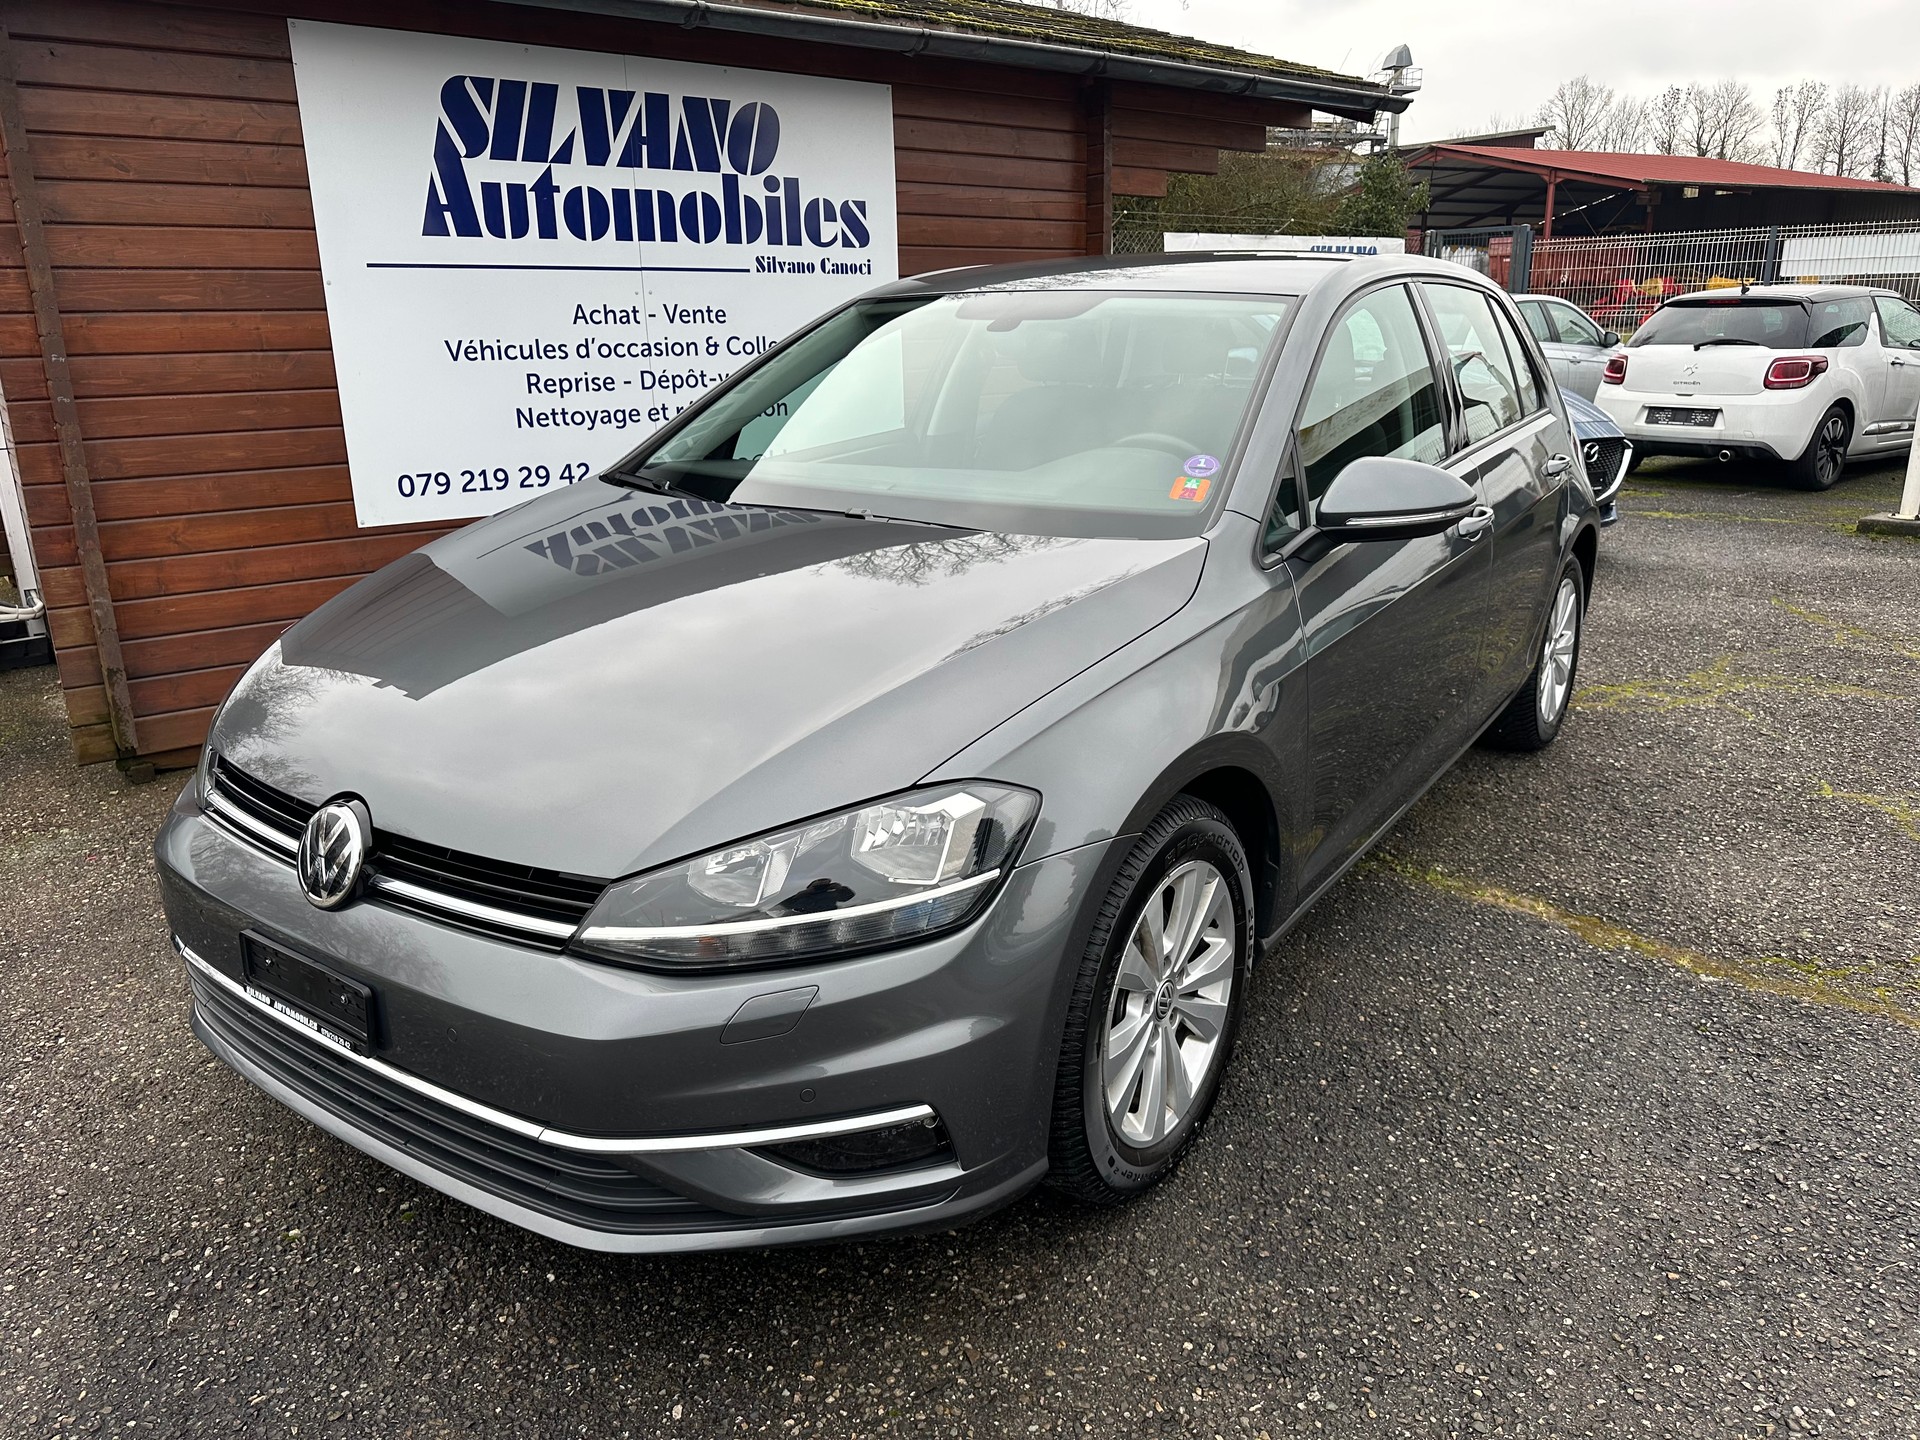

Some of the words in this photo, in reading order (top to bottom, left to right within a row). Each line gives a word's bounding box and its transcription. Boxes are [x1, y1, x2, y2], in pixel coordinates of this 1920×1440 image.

[434, 75, 781, 176] SILVANO
[422, 158, 871, 249] Automobiles
[755, 255, 815, 274] Silvano
[820, 257, 872, 276] Canoci
[572, 303, 640, 325] Achat
[662, 303, 727, 324] Vente
[444, 338, 569, 362] Véhicules
[575, 337, 699, 360] d’occasion
[705, 335, 720, 356] &
[526, 373, 616, 399] Reprise
[515, 407, 641, 431] Nettoyage
[647, 403, 670, 423] et
[1197, 458, 1207, 468] 1
[397, 471, 451, 498] 079
[460, 467, 509, 493] 219
[517, 465, 551, 489] 29
[559, 461, 590, 485] 42
[273, 1001, 318, 1030] AUTOMOBILES
